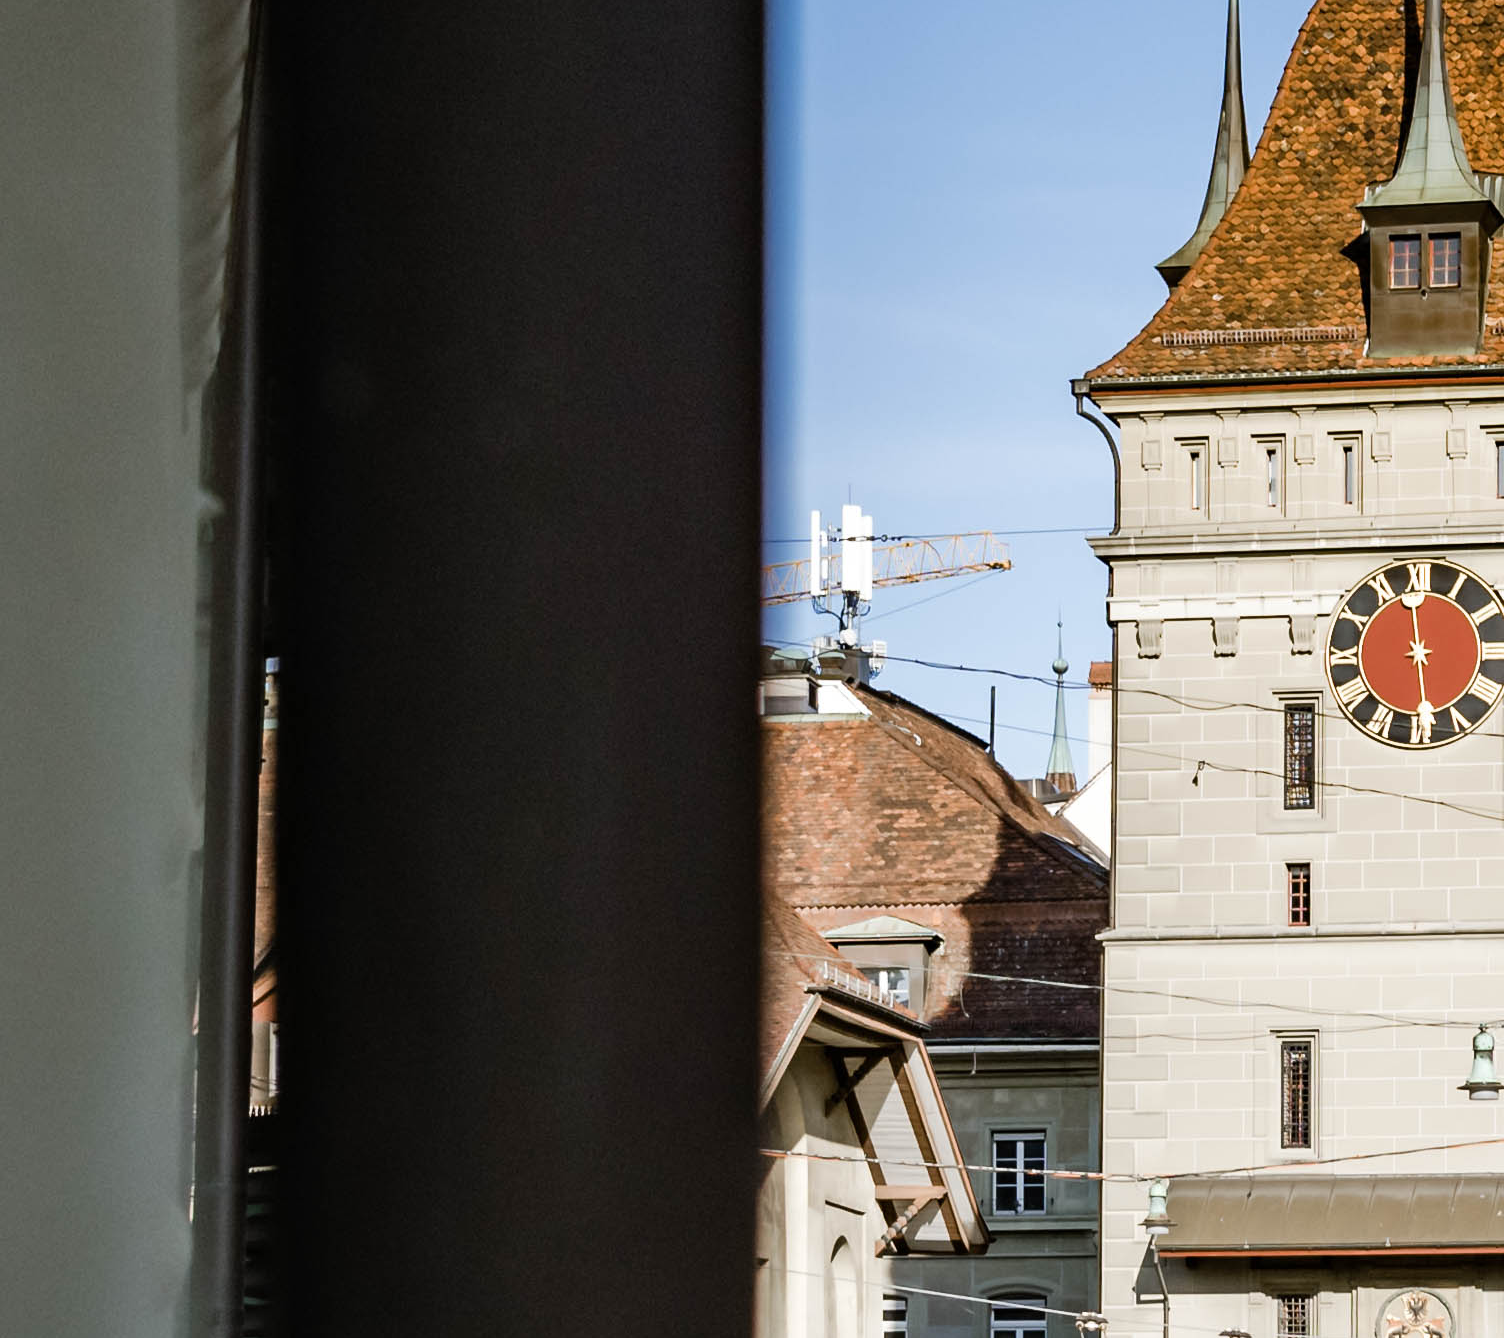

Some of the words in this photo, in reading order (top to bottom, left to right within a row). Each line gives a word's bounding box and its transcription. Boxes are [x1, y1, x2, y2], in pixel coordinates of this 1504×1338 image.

[1367, 573, 1396, 606] XI
[1404, 563, 1431, 593] XII
[1447, 572, 1468, 601] I
[1338, 605, 1370, 632] X
[1470, 601, 1500, 627] II
[1330, 646, 1358, 667] IX
[1335, 675, 1370, 714] VIII
[1449, 706, 1473, 733] V
